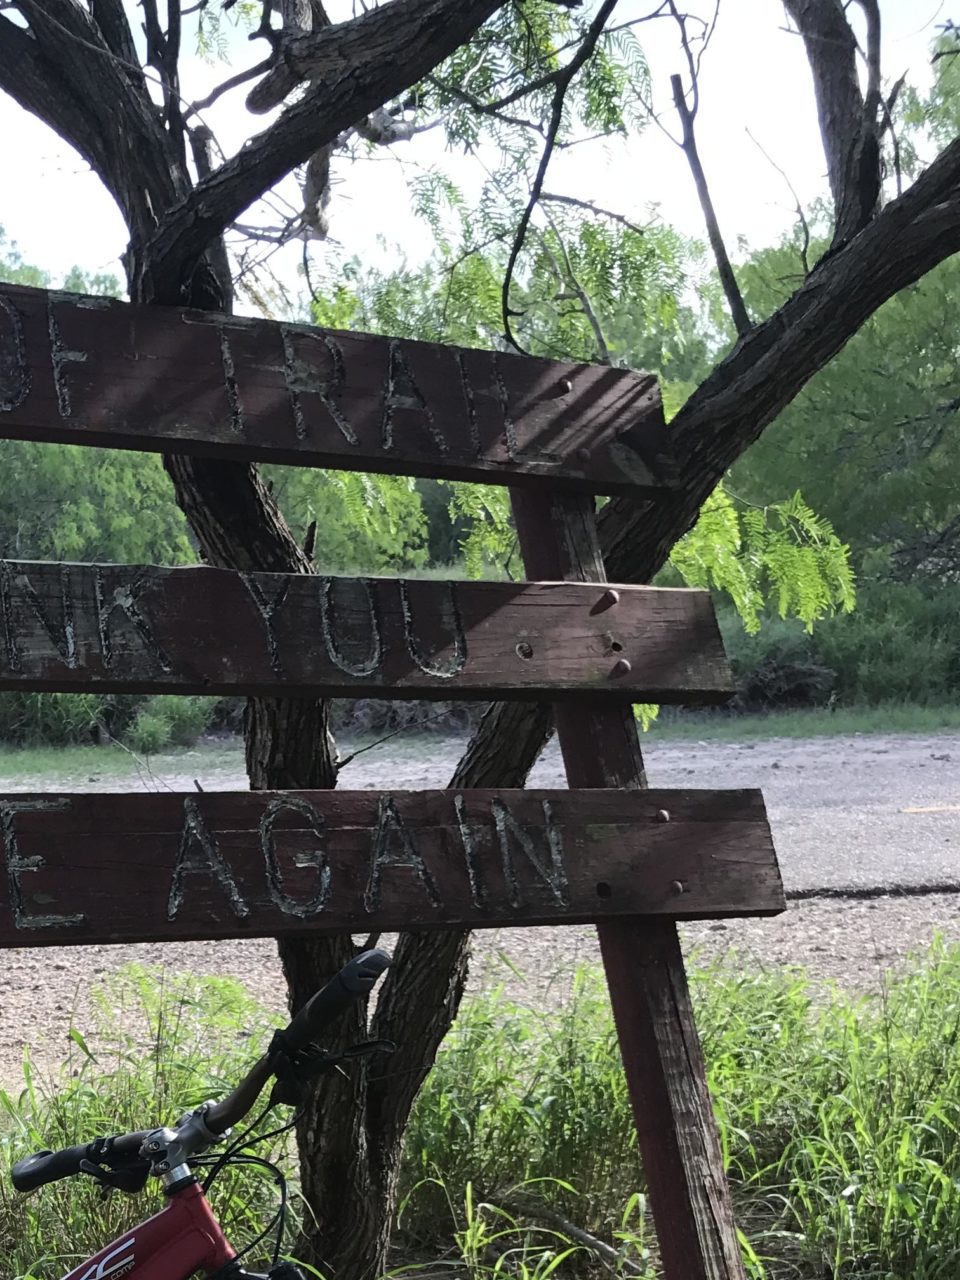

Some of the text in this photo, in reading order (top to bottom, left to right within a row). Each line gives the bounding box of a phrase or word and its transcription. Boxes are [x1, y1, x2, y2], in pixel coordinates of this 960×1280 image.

[182, 308, 567, 465] TRAIL
[237, 570, 468, 679] YOU
[167, 794, 570, 921] AGAIN
